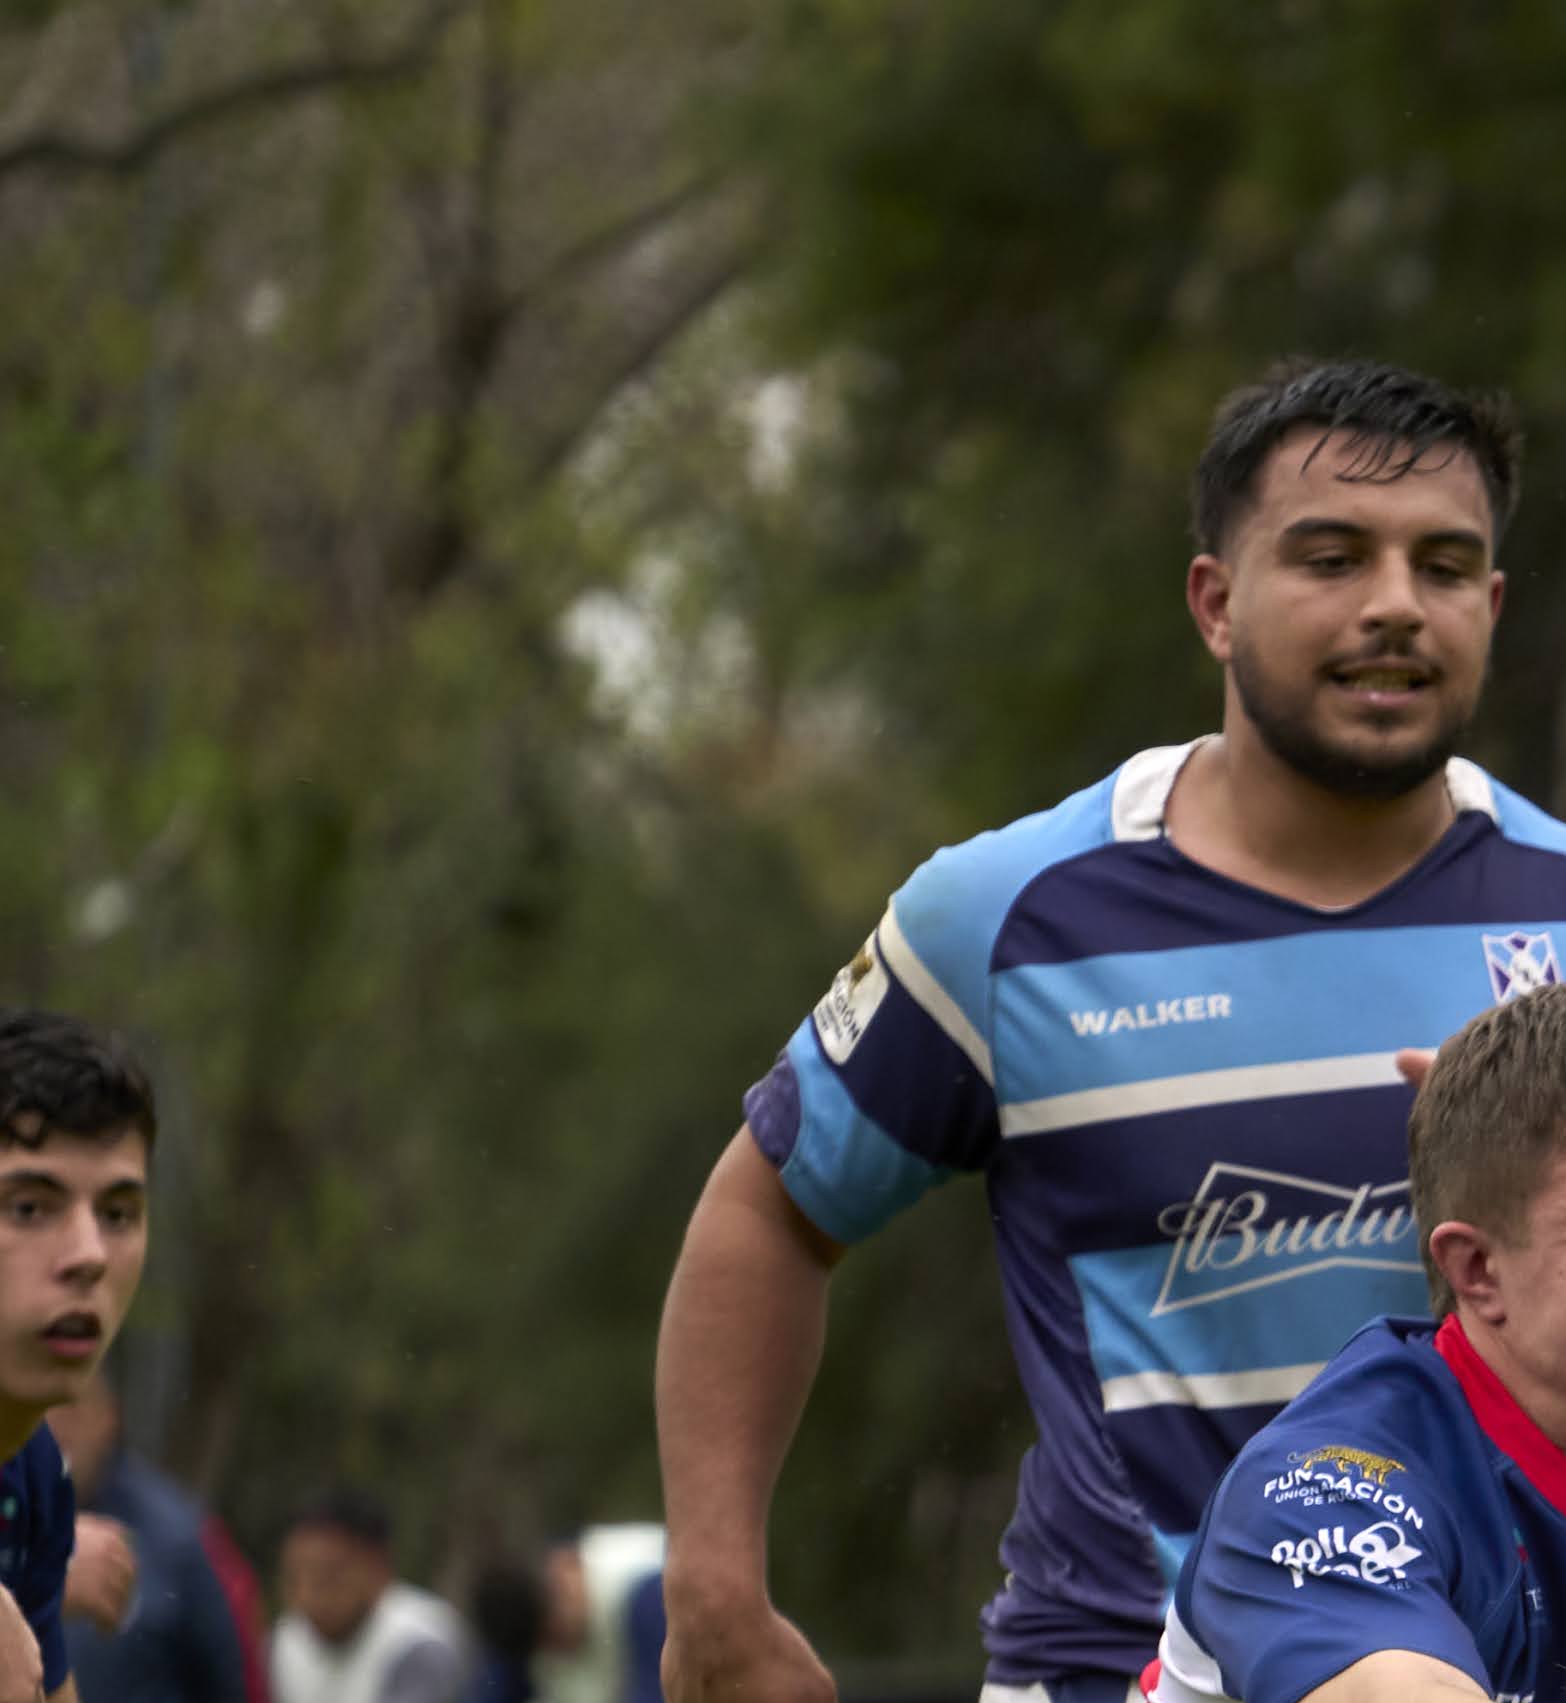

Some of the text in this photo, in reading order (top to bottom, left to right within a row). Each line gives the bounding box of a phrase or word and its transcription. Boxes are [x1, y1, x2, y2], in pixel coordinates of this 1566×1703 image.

[1069, 993, 1232, 1037] WALKER
[1303, 1490, 1360, 1507] DE RUG
